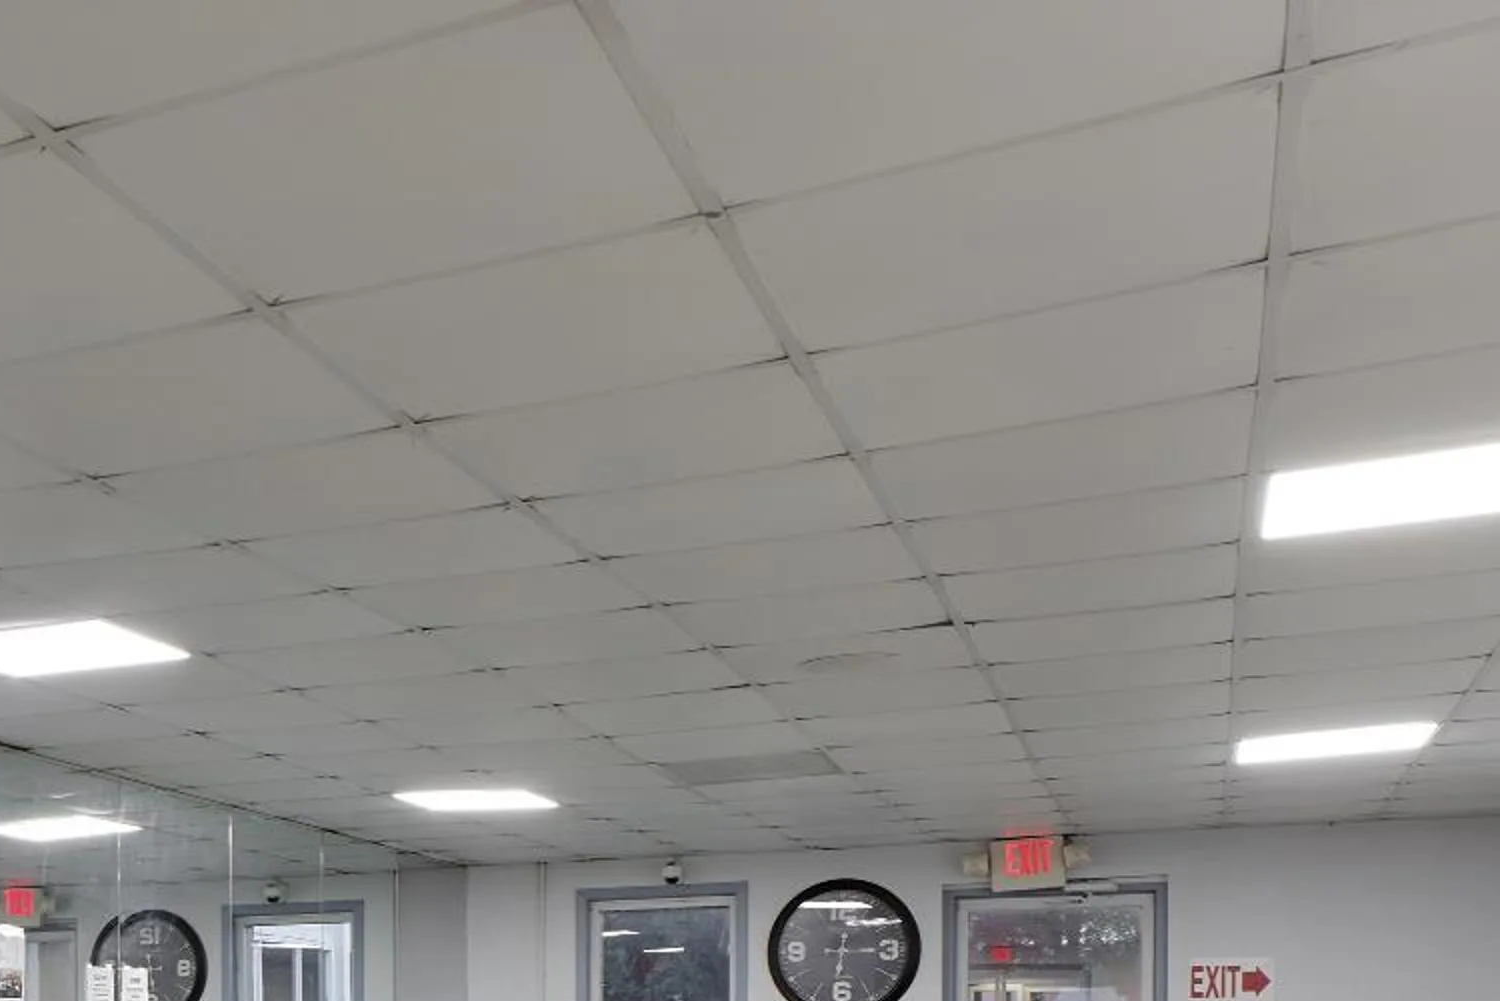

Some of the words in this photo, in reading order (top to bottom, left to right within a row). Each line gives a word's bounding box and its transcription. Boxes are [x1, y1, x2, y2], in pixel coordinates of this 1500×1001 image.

[1004, 840, 1055, 876] EXIT
[879, 939, 900, 961] 3
[1189, 965, 1240, 999] EXIT
